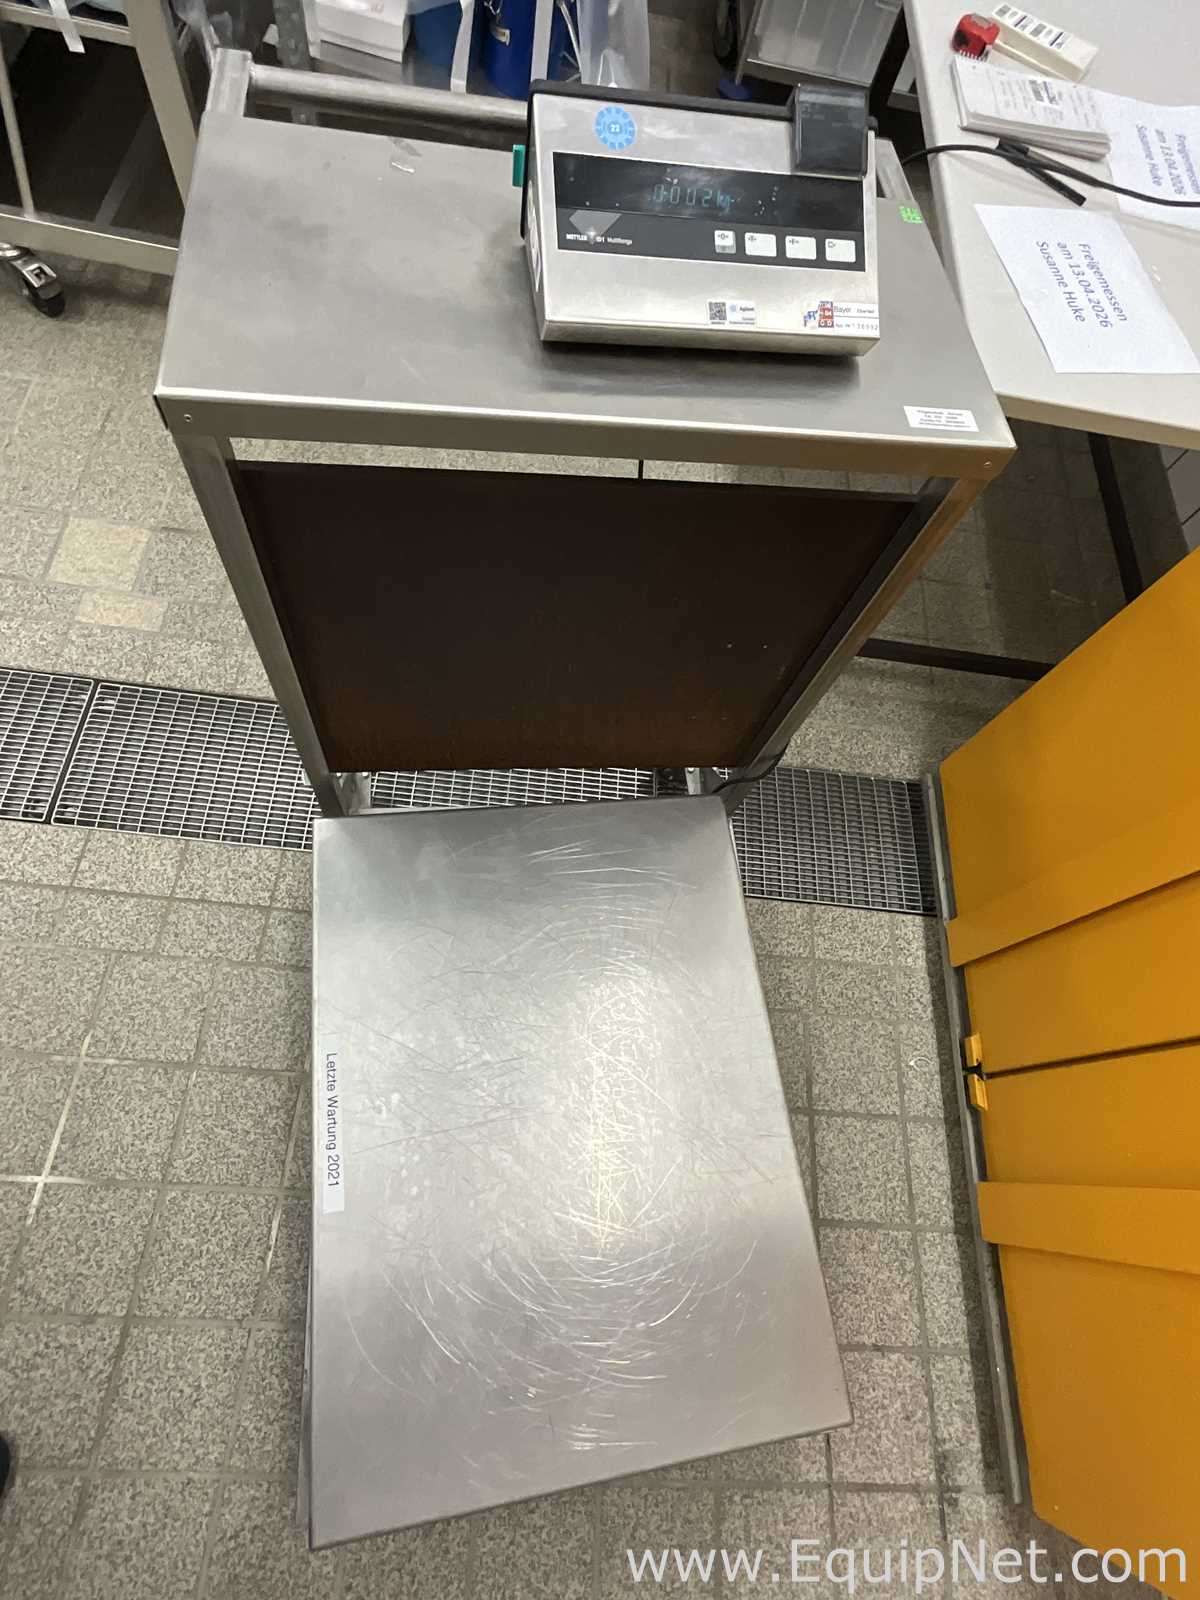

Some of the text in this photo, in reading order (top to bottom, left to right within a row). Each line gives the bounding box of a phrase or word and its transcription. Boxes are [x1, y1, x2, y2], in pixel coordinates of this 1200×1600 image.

[1036, 240, 1086, 323] Susanne Huke
[1056, 241, 1114, 329] am 13.04.2026
[1078, 242, 1128, 322] Freigemessen
[326, 1052, 340, 1187] Letzte Wartung 2021
